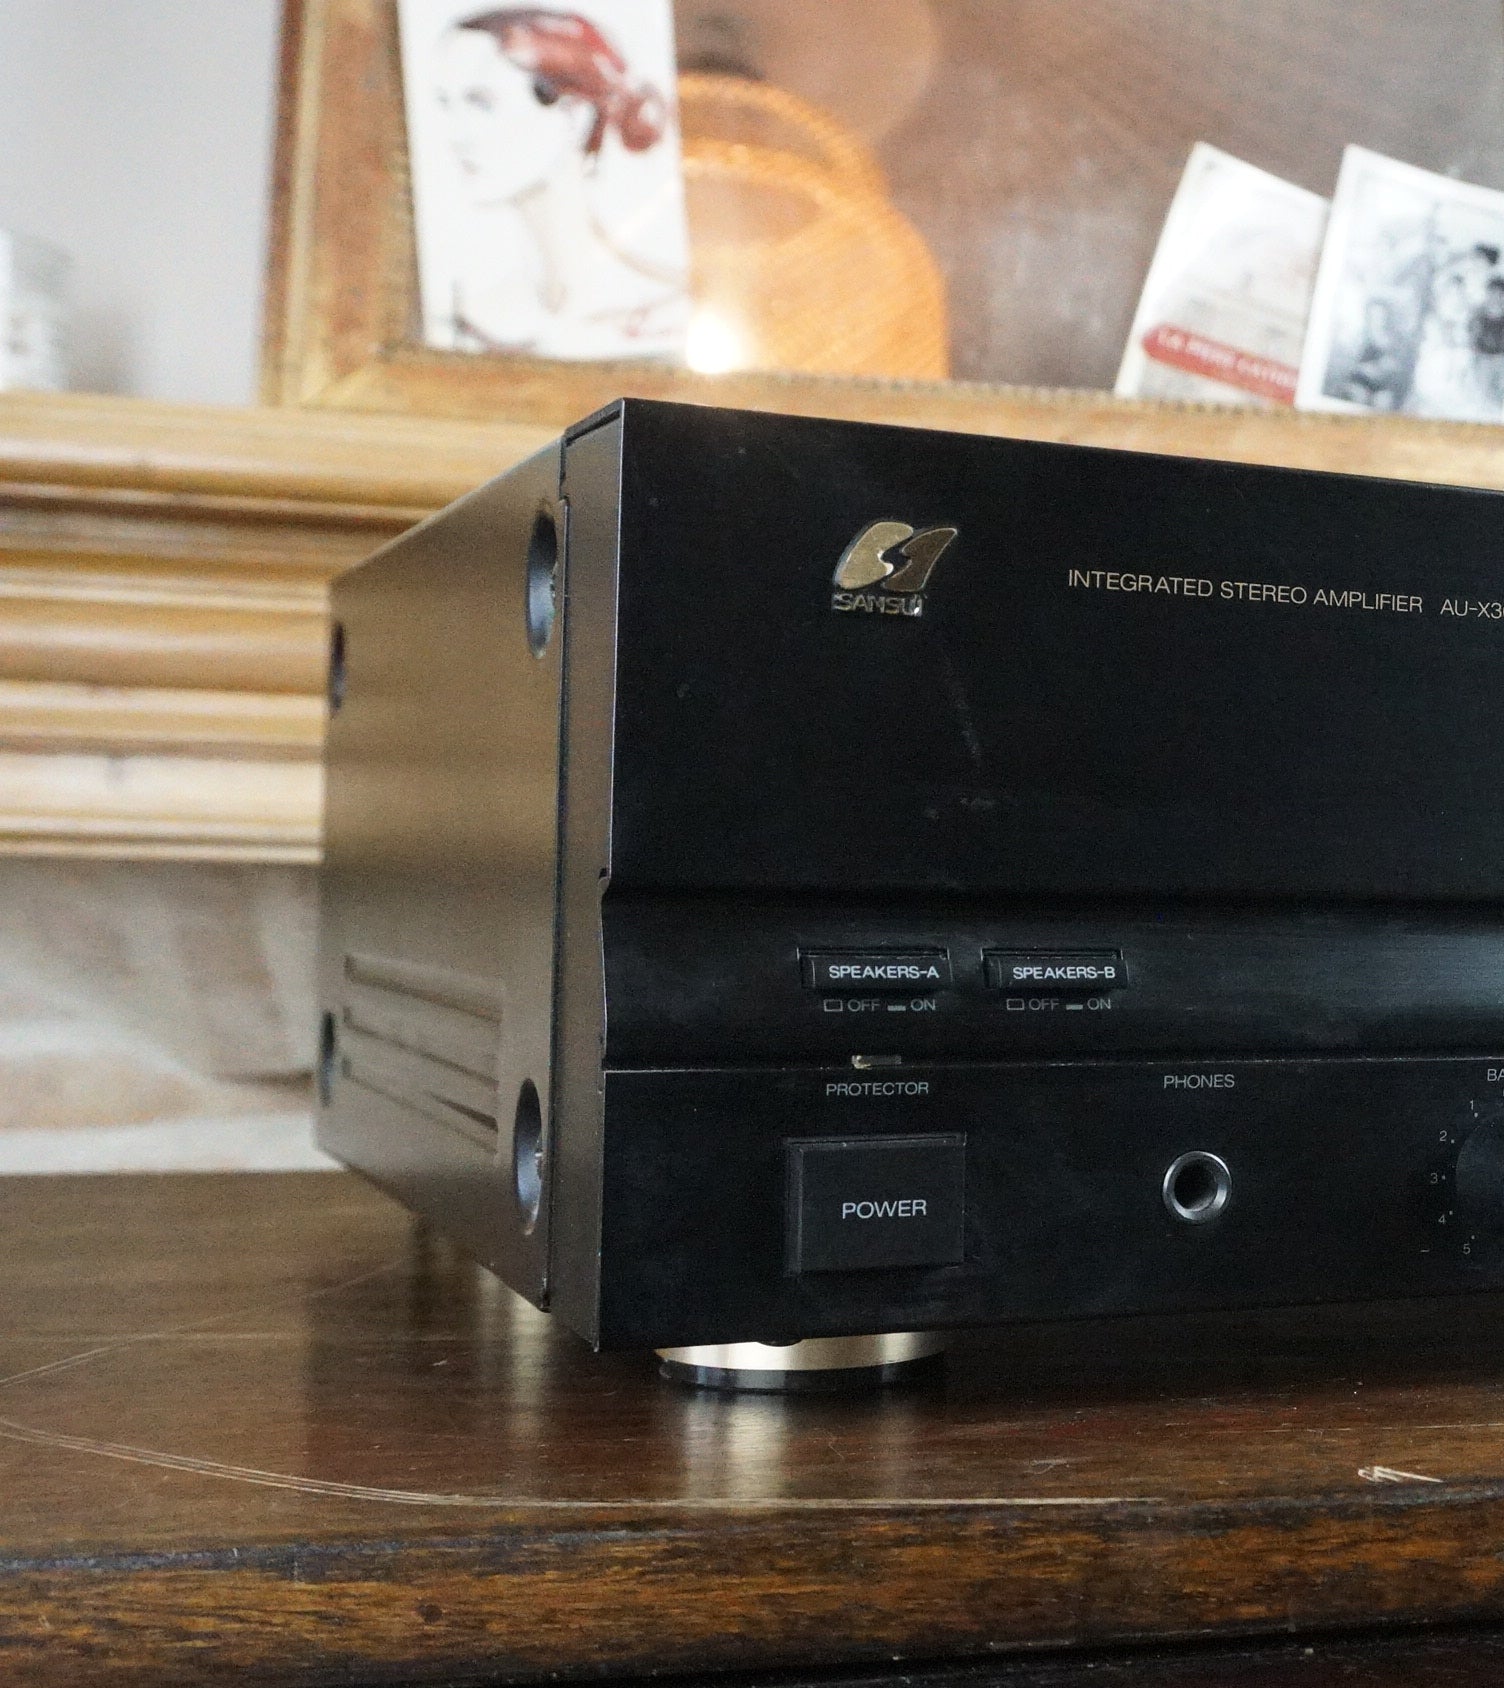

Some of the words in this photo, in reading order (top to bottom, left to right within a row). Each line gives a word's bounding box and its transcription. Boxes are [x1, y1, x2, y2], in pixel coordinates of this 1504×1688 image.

[1067, 569, 1214, 598] INTEGRATED
[1220, 580, 1308, 605] STEREO
[1312, 588, 1424, 614] AMPLIFIER
[828, 964, 940, 980] SPEAKERS-A
[1012, 965, 1117, 980] SPEAKERS-B
[847, 998, 881, 1013] OFF
[909, 998, 937, 1012] ON
[1028, 997, 1060, 1012] OFF
[1086, 997, 1113, 1011] ON
[825, 1081, 930, 1097] PROTECTOR
[1162, 1073, 1236, 1090] PHONES
[1469, 1099, 1475, 1111] 1
[1439, 1130, 1448, 1142] 2
[1430, 1172, 1439, 1184] 3
[841, 1199, 928, 1220] POWER
[1438, 1214, 1447, 1225] 4
[1462, 1243, 1471, 1255] 5
